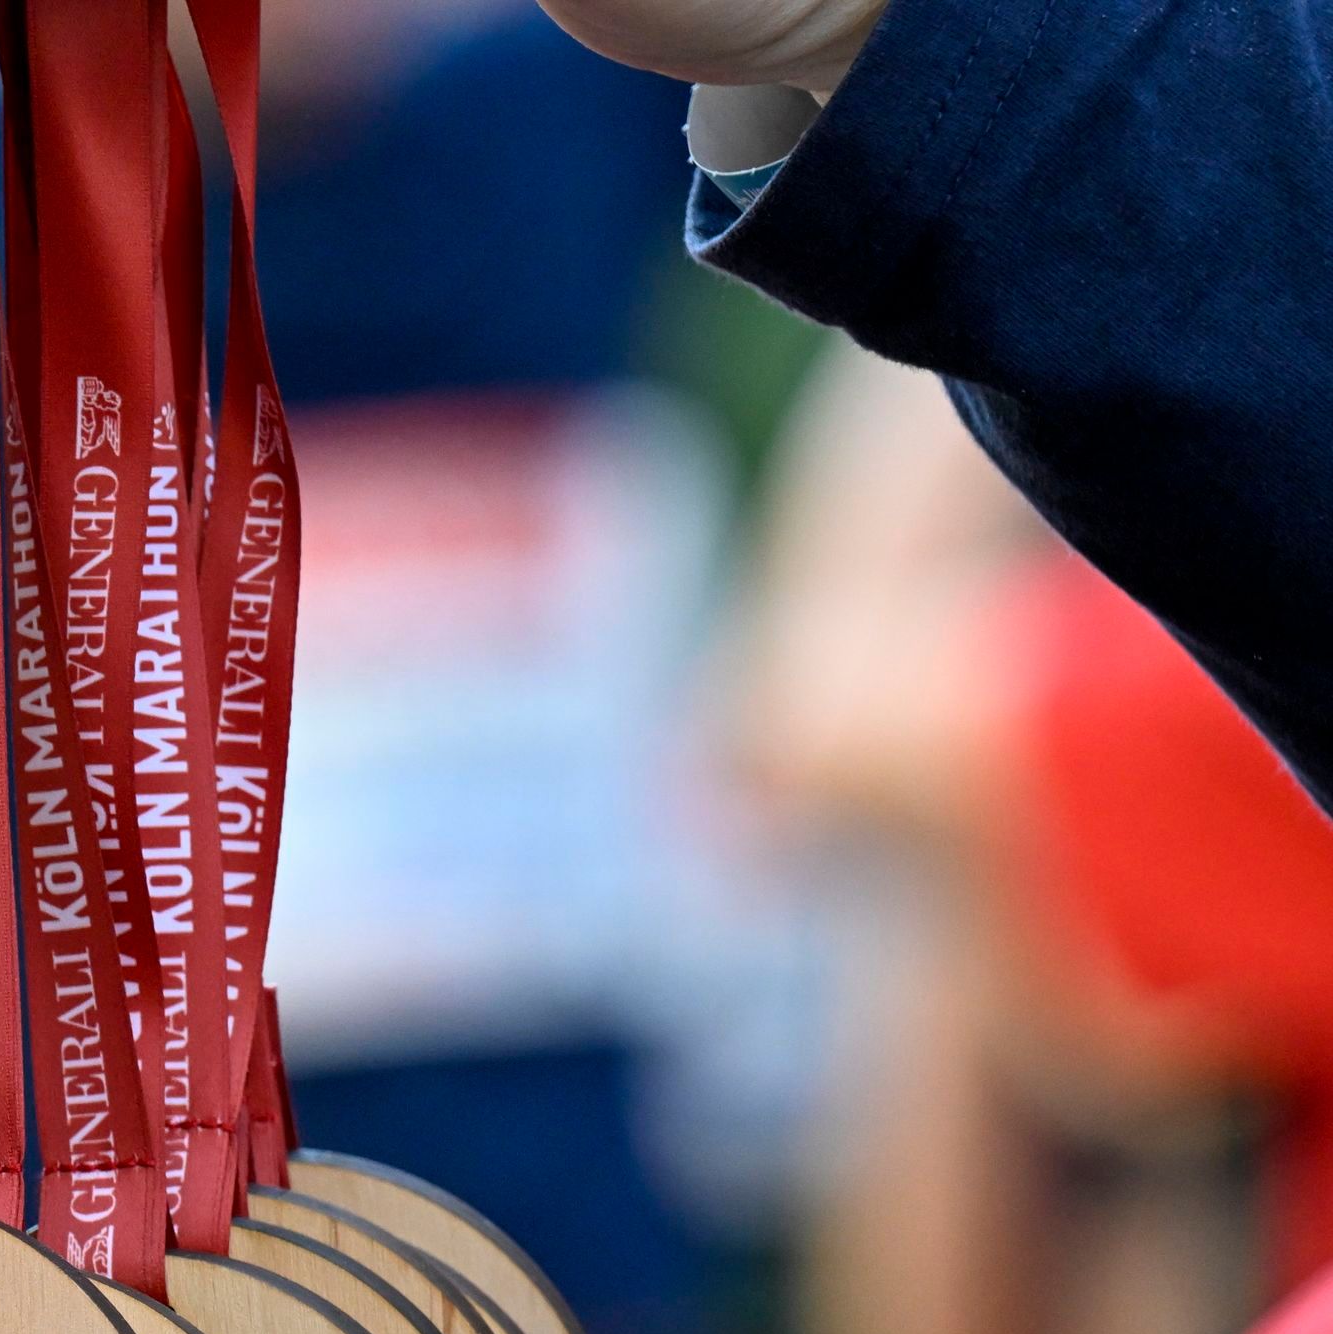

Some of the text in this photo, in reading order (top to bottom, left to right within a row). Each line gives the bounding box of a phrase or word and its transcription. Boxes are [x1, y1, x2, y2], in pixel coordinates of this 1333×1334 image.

[7, 462, 117, 1223] GENERALI KÖLN MARATHON
[216, 472, 286, 749] GENERALI
